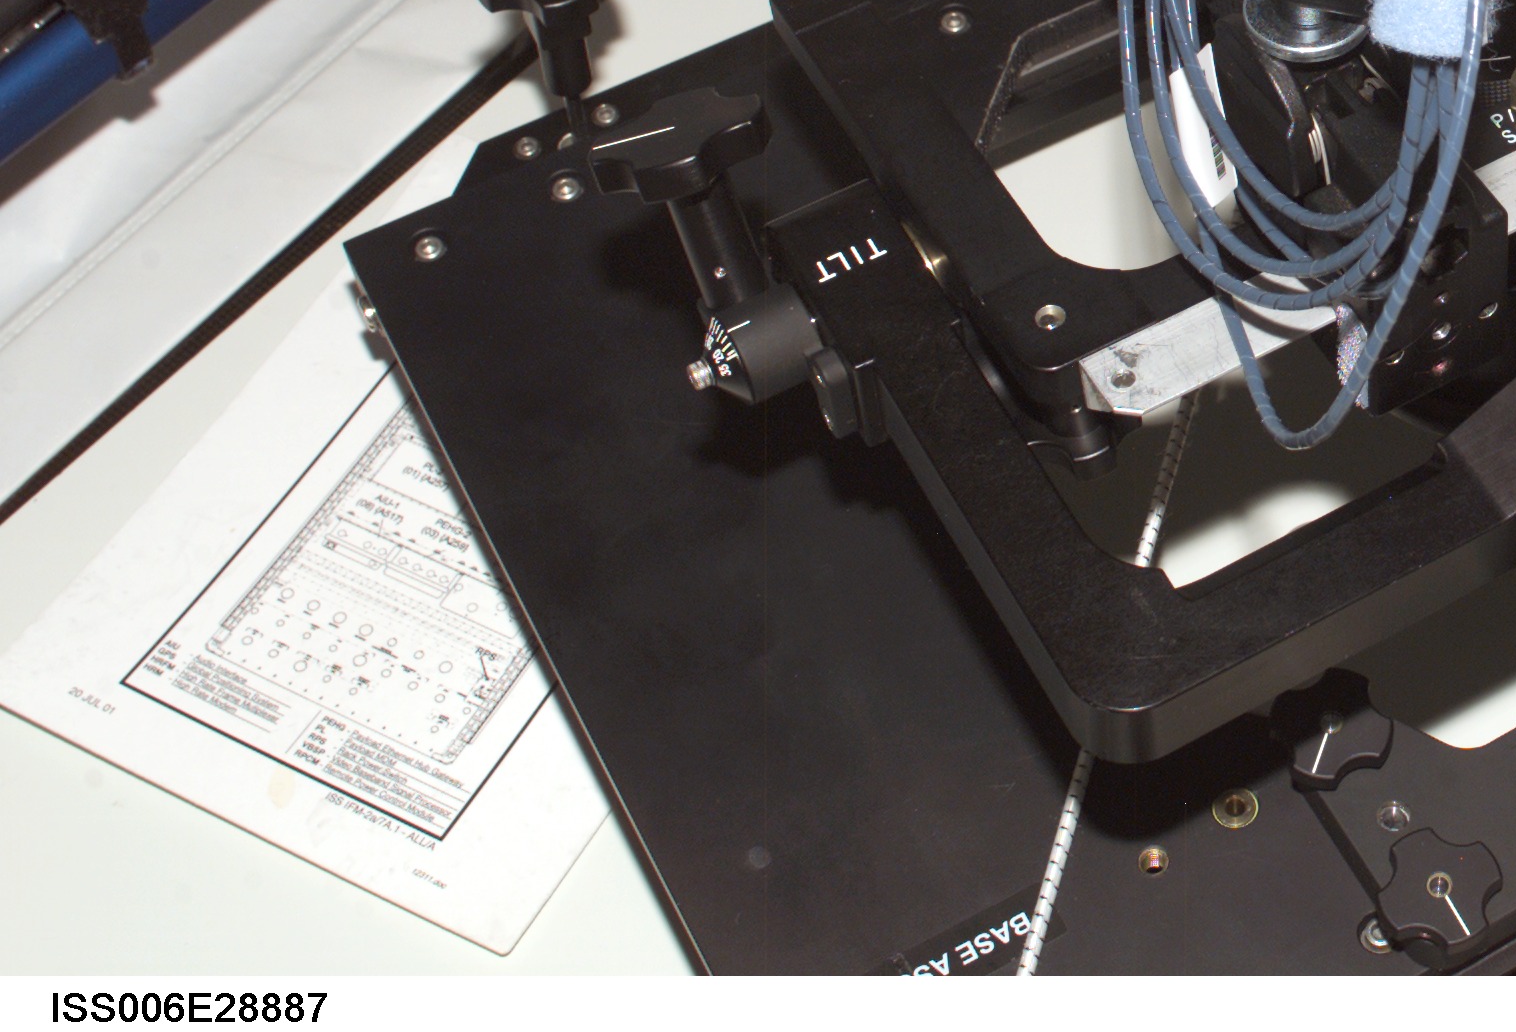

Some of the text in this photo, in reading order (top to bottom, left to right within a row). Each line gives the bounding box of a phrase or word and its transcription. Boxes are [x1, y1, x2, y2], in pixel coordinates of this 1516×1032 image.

[816, 237, 888, 284] TILT
[67, 685, 84, 698] 20
[80, 693, 101, 709] JUL
[214, 664, 248, 685] Interface
[324, 792, 344, 805] ISS
[406, 830, 437, 851] ALL/A
[953, 910, 1032, 966] BASE
